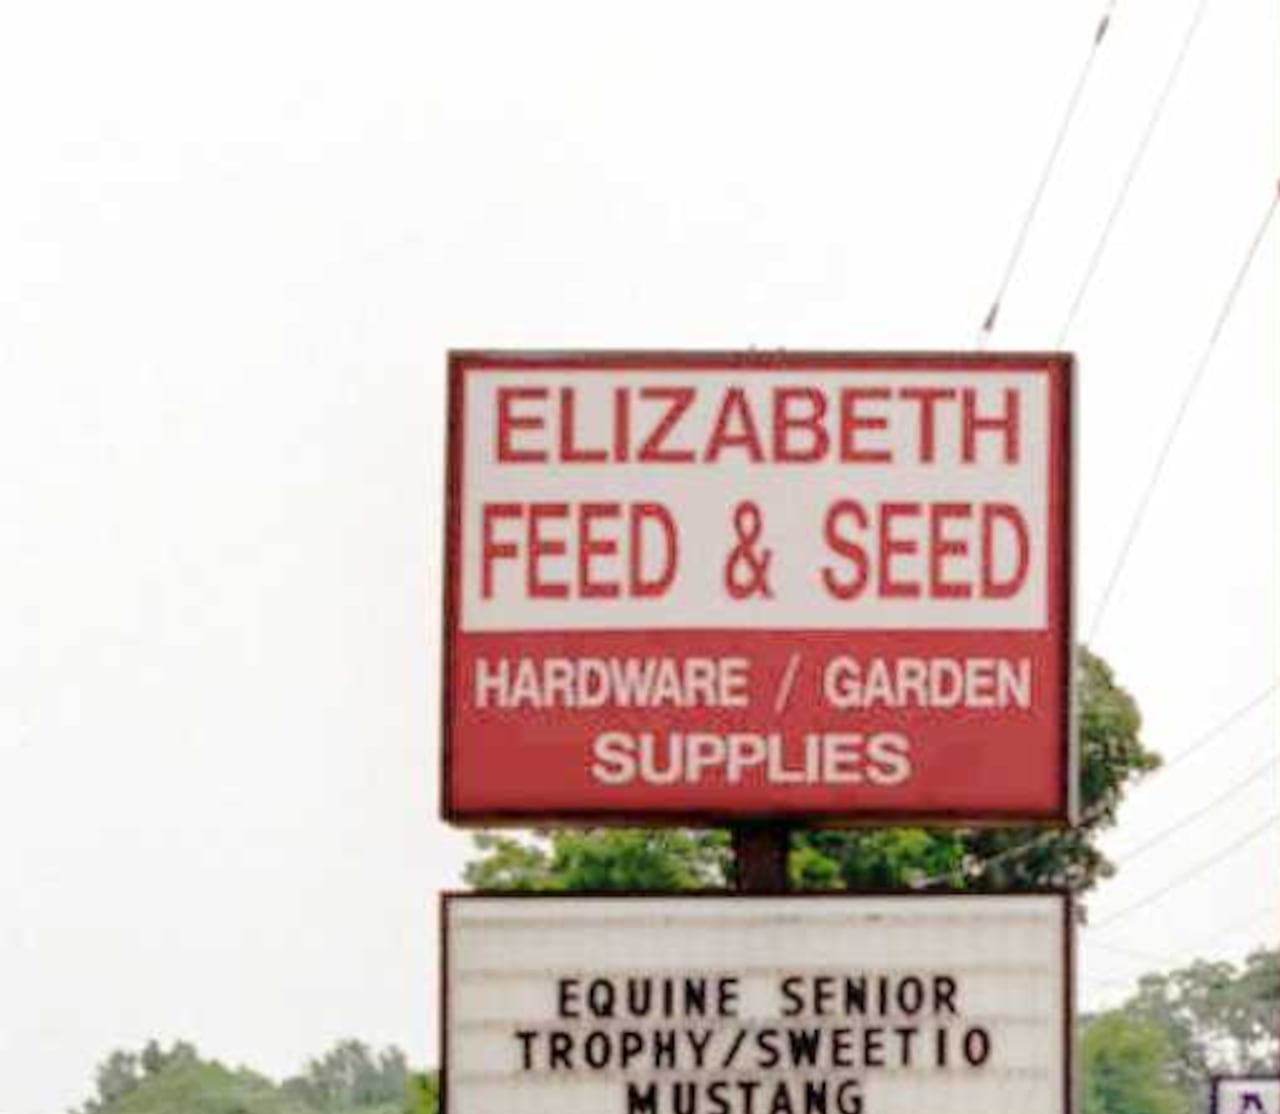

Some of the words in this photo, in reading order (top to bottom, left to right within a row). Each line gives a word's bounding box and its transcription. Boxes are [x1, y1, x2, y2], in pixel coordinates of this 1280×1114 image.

[495, 386, 1020, 464] ELIZABETH
[481, 502, 678, 600] FEED
[724, 500, 773, 600] &
[822, 499, 1029, 601] SEED
[475, 657, 749, 709] HARDWARE
[774, 653, 801, 713] /
[823, 656, 1031, 709] GARDEN
[592, 731, 912, 786] SUPPLIES
[558, 978, 740, 1019] EQUINE
[780, 976, 958, 1016] SENIOR
